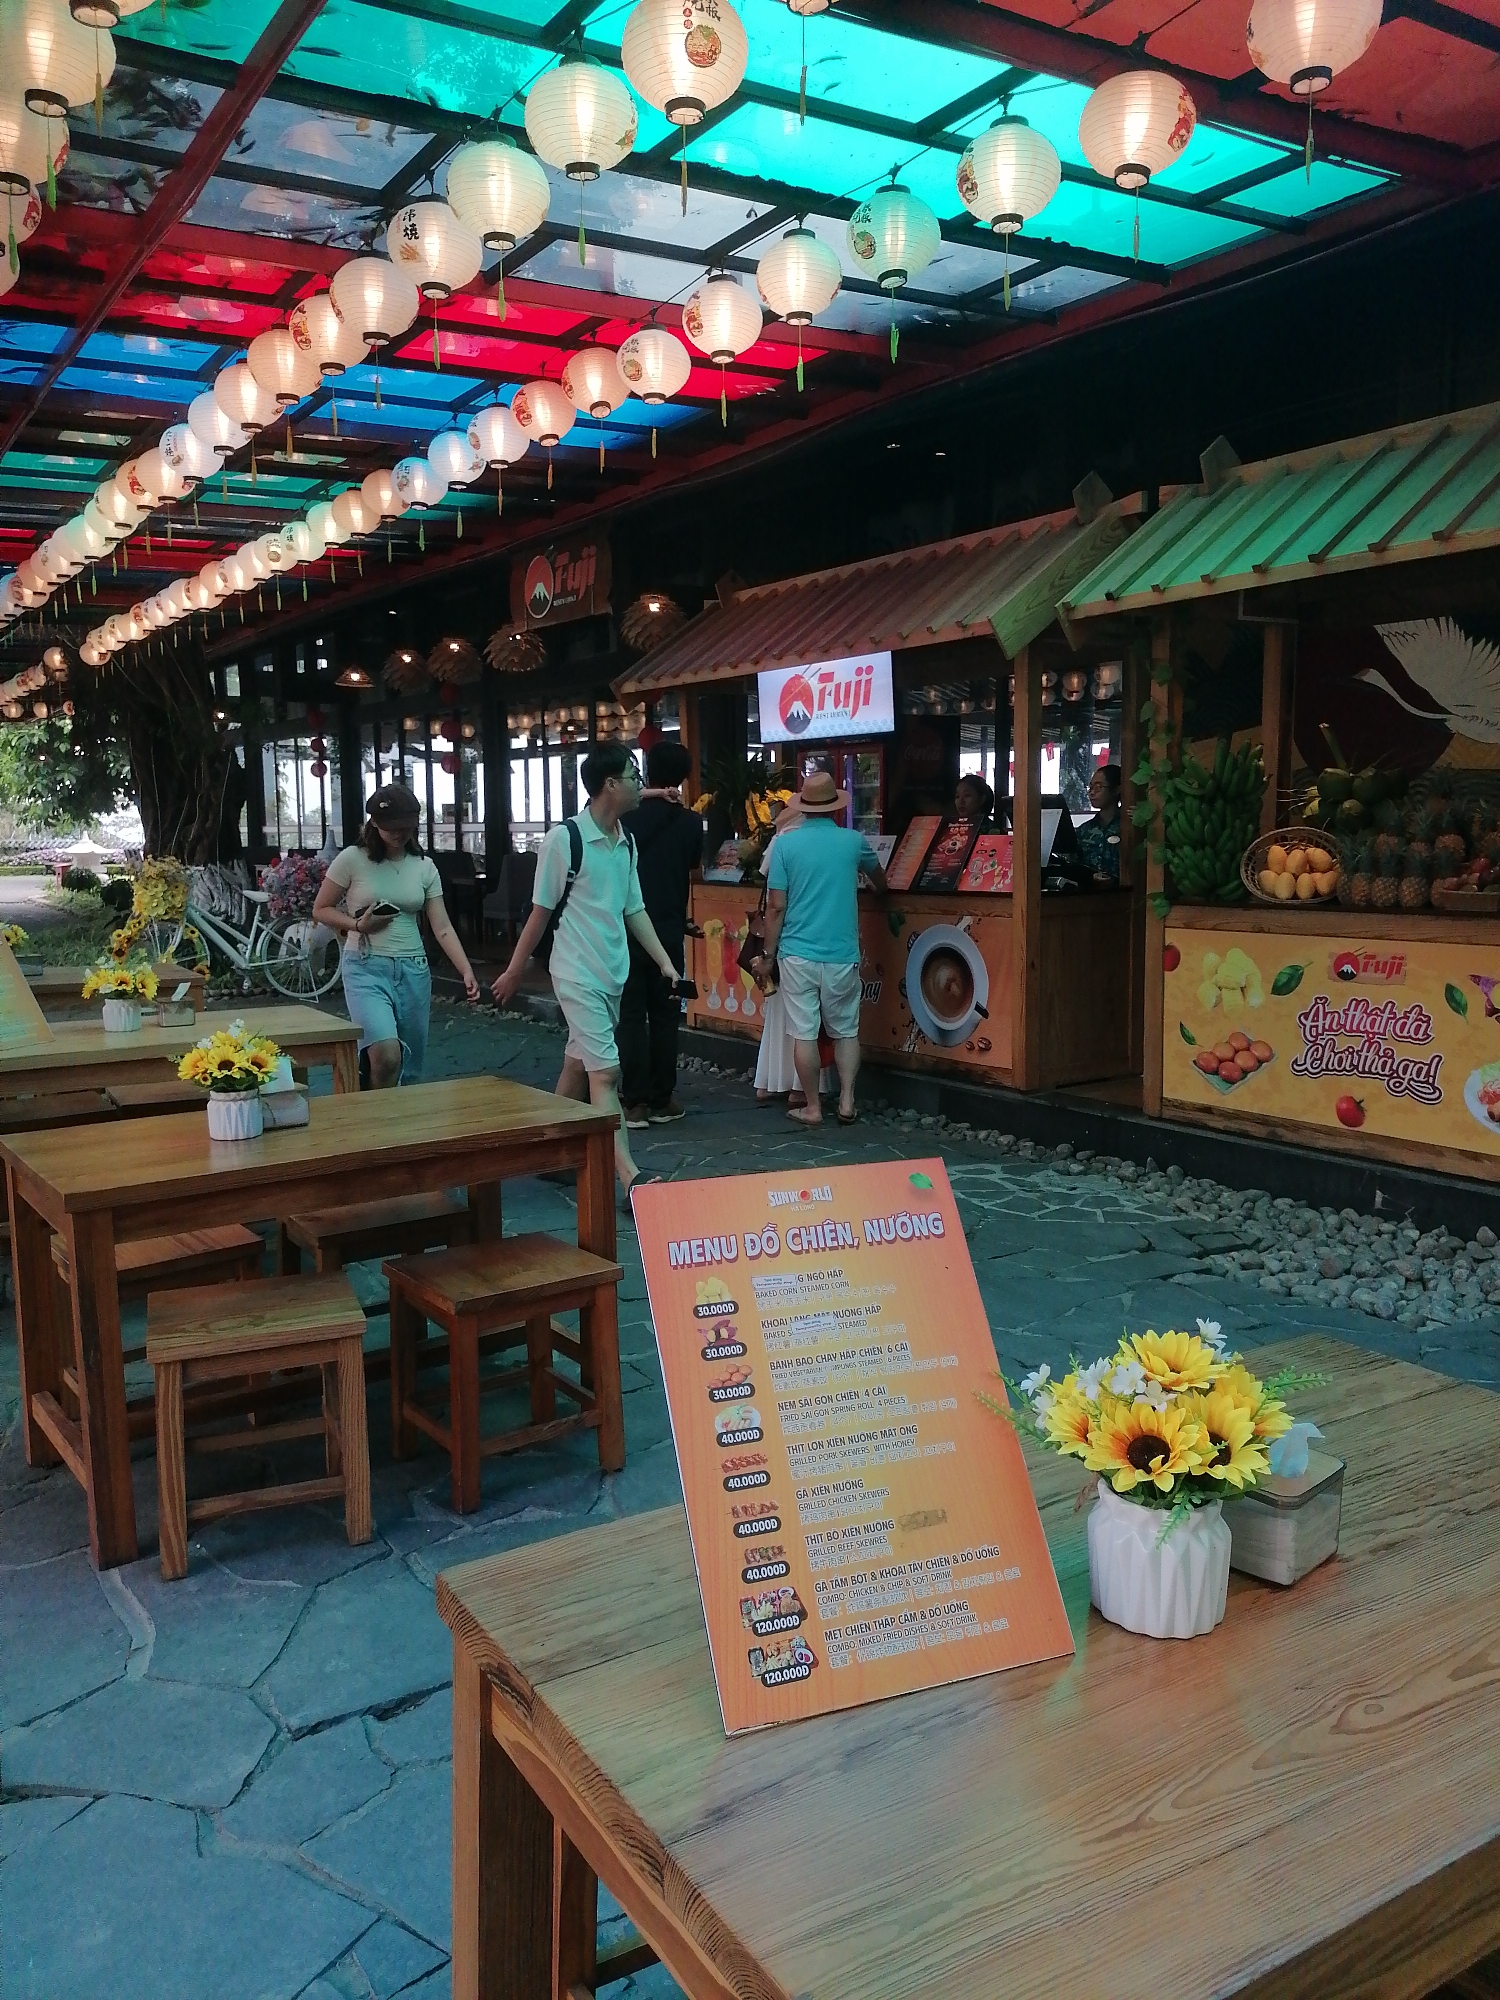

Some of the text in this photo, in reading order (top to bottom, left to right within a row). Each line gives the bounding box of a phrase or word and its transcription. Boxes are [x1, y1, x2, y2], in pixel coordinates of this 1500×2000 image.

[554, 545, 597, 600] Fuji
[817, 665, 874, 720] Fuji
[1361, 953, 1405, 980] Fuji
[1298, 996, 1434, 1044] Ăn thật đã
[1291, 1038, 1356, 1077] Chơi
[1357, 1040, 1396, 1078] thả
[668, 1210, 946, 1268] MENU ĐỒ CHIÊN, NƯỚNG
[829, 1279, 850, 1291] CORN
[760, 1317, 788, 1330] KHOAI
[762, 1330, 786, 1341] BAKED
[794, 1355, 814, 1367] BAO
[770, 1370, 788, 1381] FRIED
[776, 1399, 797, 1412] NEM
[779, 1411, 800, 1424] FRIED
[812, 1407, 830, 1419] GON
[829, 1403, 856, 1416] SPRING
[856, 1400, 874, 1412] ROLL
[898, 1424, 918, 1437] ONG
[788, 1437, 918, 1467] GRILLED PORK SKEWERS WITH HONEY
[797, 1487, 890, 1512] GRILLED CHICKEN SKEWERS
[806, 1544, 836, 1559] GRILLED
[836, 1541, 855, 1553] BEEF
[868, 1570, 878, 1582] &
[878, 1564, 907, 1580] KHOAI
[950, 1554, 959, 1565] &
[847, 1584, 878, 1599] CHICKEN
[886, 1579, 904, 1591] CHIP
[904, 1578, 911, 1588] &
[911, 1574, 930, 1586] SOFT
[929, 1569, 953, 1583] DRINK
[918, 1609, 928, 1621] &
[857, 1633, 882, 1648] MIXED
[881, 1629, 903, 1643] FRIED
[903, 1623, 929, 1638] DISHES
[929, 1622, 937, 1632] &
[936, 1618, 955, 1631] SOFT
[954, 1613, 978, 1627] DRINK
